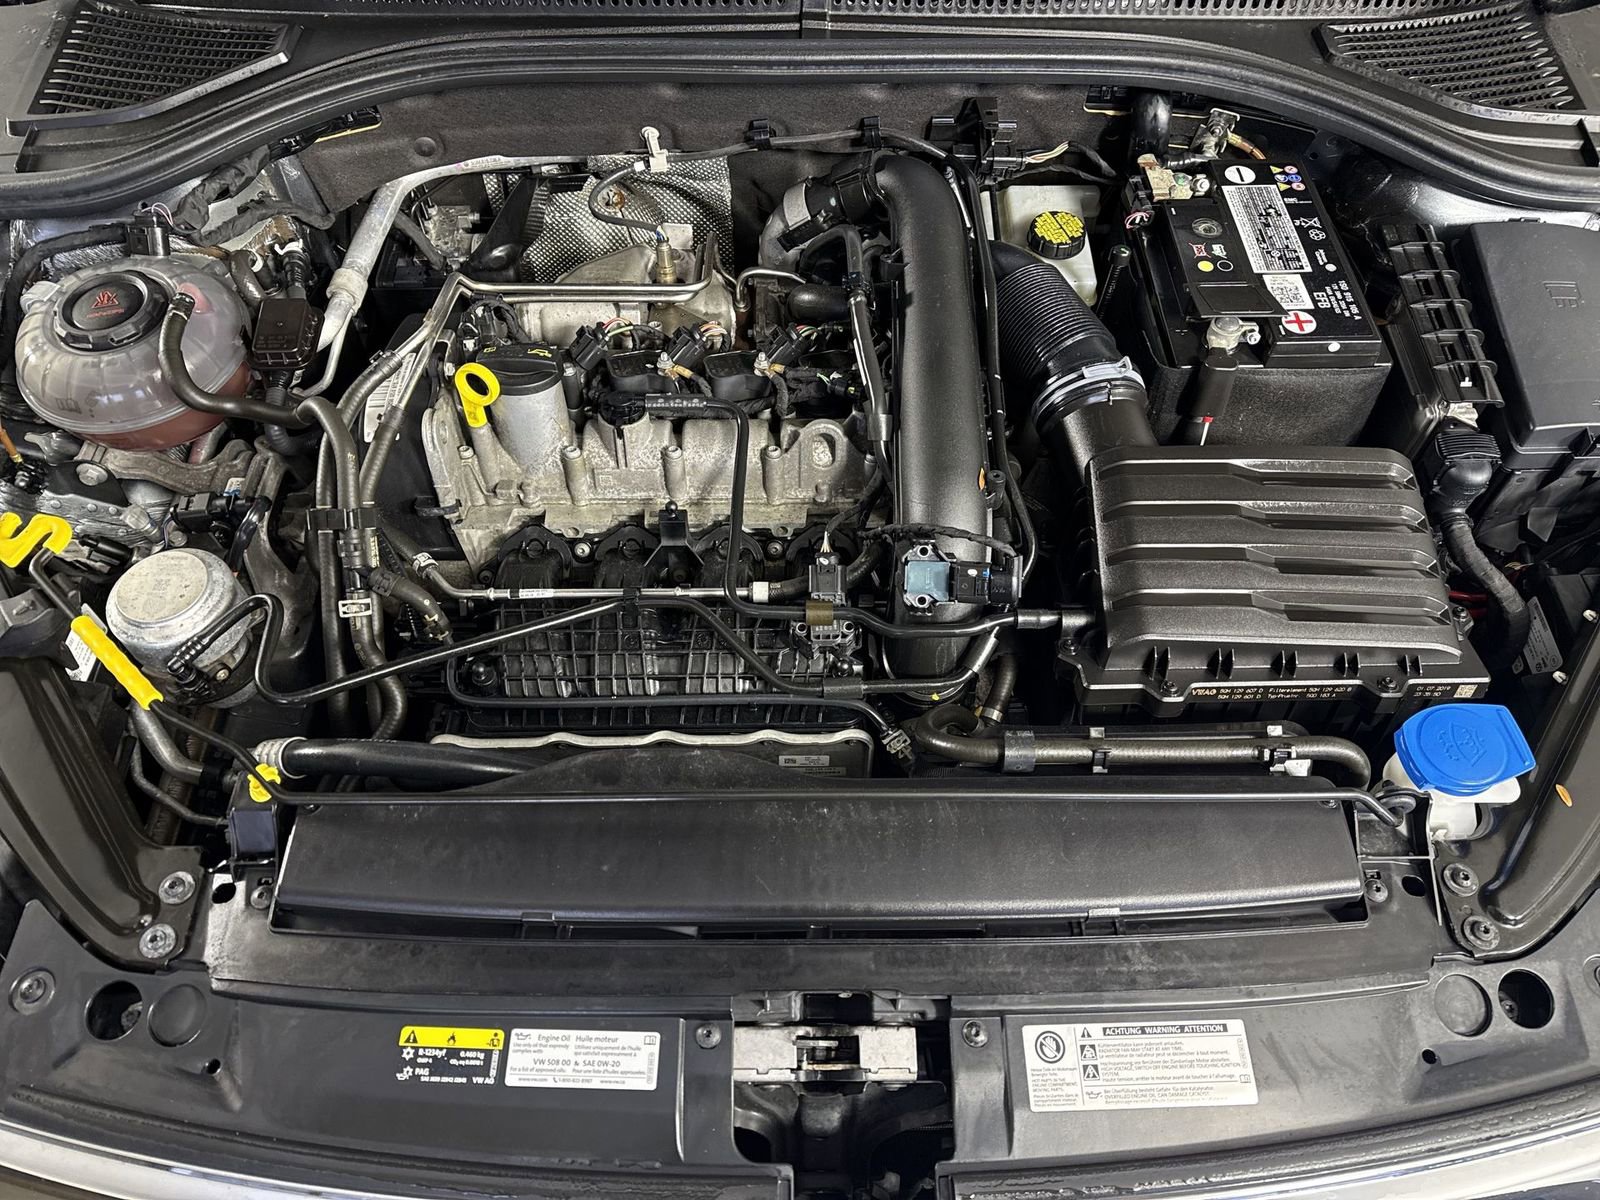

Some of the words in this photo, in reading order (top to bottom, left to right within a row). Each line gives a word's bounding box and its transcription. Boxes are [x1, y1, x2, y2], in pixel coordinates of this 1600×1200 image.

[1313, 292, 1331, 309] EFB
[1105, 1027, 1141, 1035] ACHTUNG
[1144, 1026, 1180, 1034] WARNING
[1184, 1025, 1223, 1033] ATTENTION
[538, 1034, 560, 1043] Engine
[594, 1035, 619, 1043] moteur
[418, 1048, 447, 1058] R-1234yf
[477, 1052, 485, 1060] kg
[414, 1067, 430, 1076] PAG
